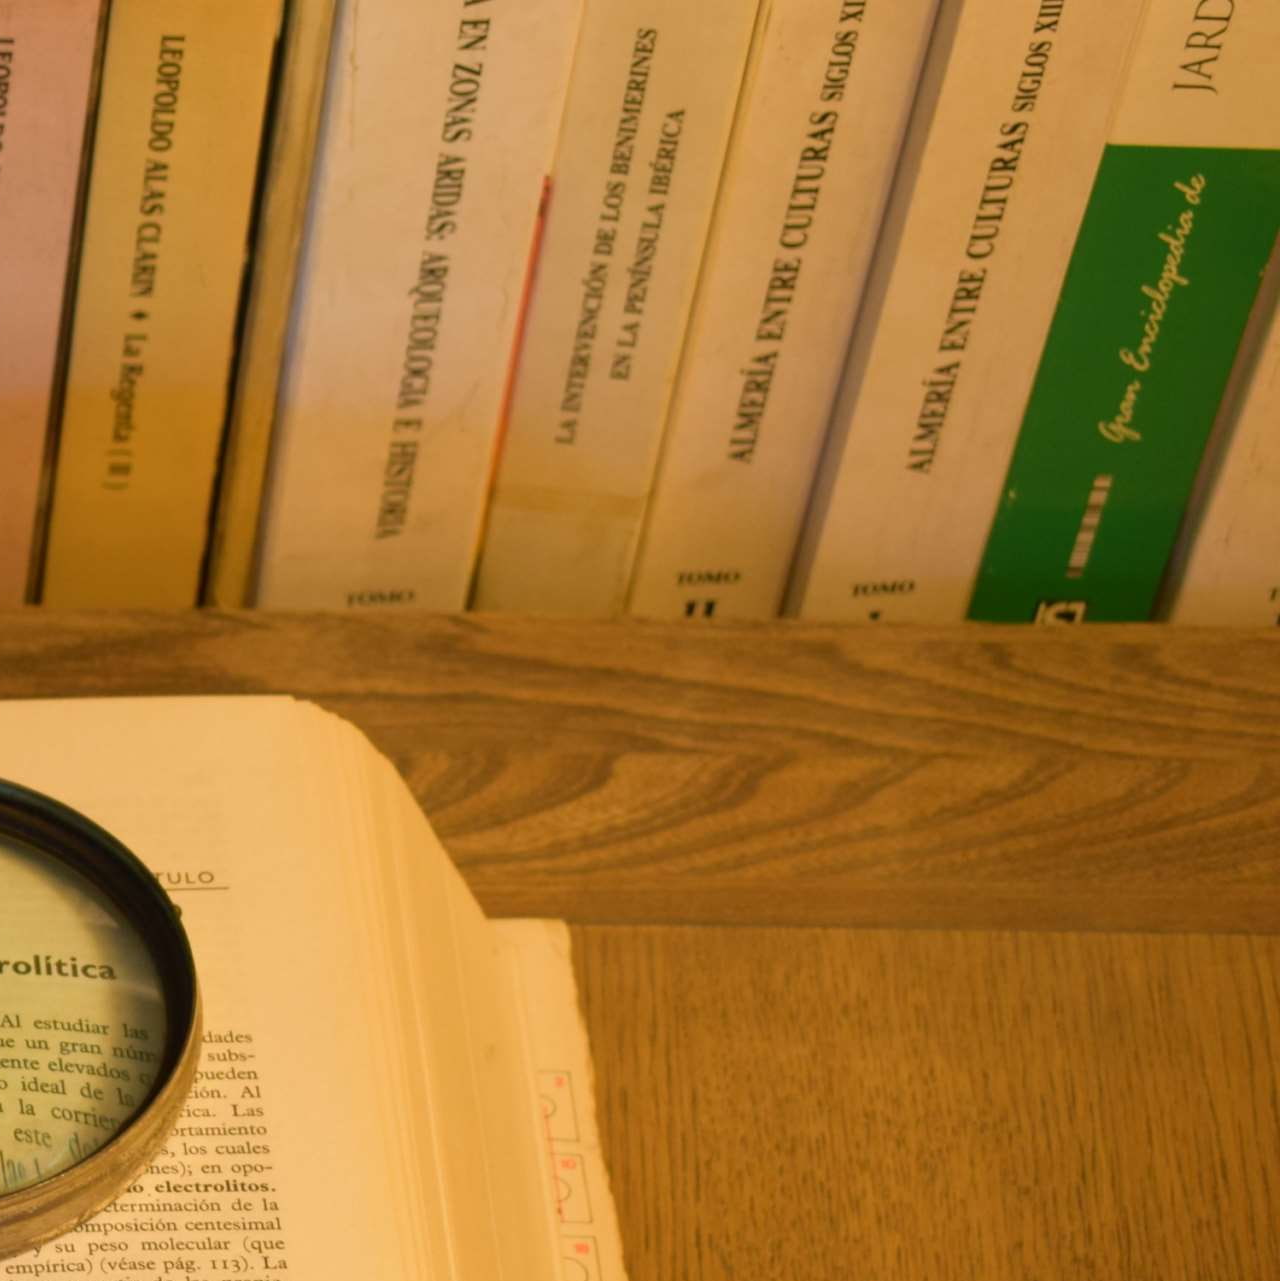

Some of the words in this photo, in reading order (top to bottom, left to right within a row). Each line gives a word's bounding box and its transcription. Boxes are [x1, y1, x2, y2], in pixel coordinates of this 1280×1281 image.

[458, 17, 491, 51] EN
[147, 34, 186, 153] LEOPOLDO
[441, 62, 484, 143] ZONAS
[609, 28, 658, 176] BENIMERINES
[647, 108, 686, 196] IBÉRICA
[138, 159, 170, 215] ALAS
[599, 181, 626, 223] LOS
[1174, 174, 1206, 205] de
[591, 227, 617, 257] DE
[623, 202, 667, 316] PENÍNSULA
[728, 350, 780, 464] ALMERÍA
[754, 258, 803, 342] ENTRE
[779, 110, 839, 250] CULTURAS
[819, 30, 859, 102] SIGLOS
[906, 360, 961, 474] ALMERÍA
[938, 269, 989, 352] ENTRE
[965, 121, 1029, 260] CULTURAS
[1010, 40, 1053, 113] SIGLOS
[1119, 209, 1194, 372] Enciclopedia
[121, 332, 149, 358] La
[560, 262, 608, 413] INTERVENCIÓN
[615, 321, 641, 349] LA
[607, 353, 633, 383] EN
[109, 363, 145, 443] Regenta
[392, 417, 425, 433] E
[1098, 380, 1141, 443] Gran
[553, 418, 579, 446] LA
[374, 441, 421, 541] HISTORIA
[0, 1014, 22, 1029] Al
[33, 1016, 110, 1036] estudiar
[123, 1022, 150, 1041] las
[25, 1037, 50, 1050] un
[59, 1040, 102, 1058] gran
[21, 1077, 67, 1095] ideal
[80, 1081, 104, 1101] de
[48, 1057, 130, 1082] elevados
